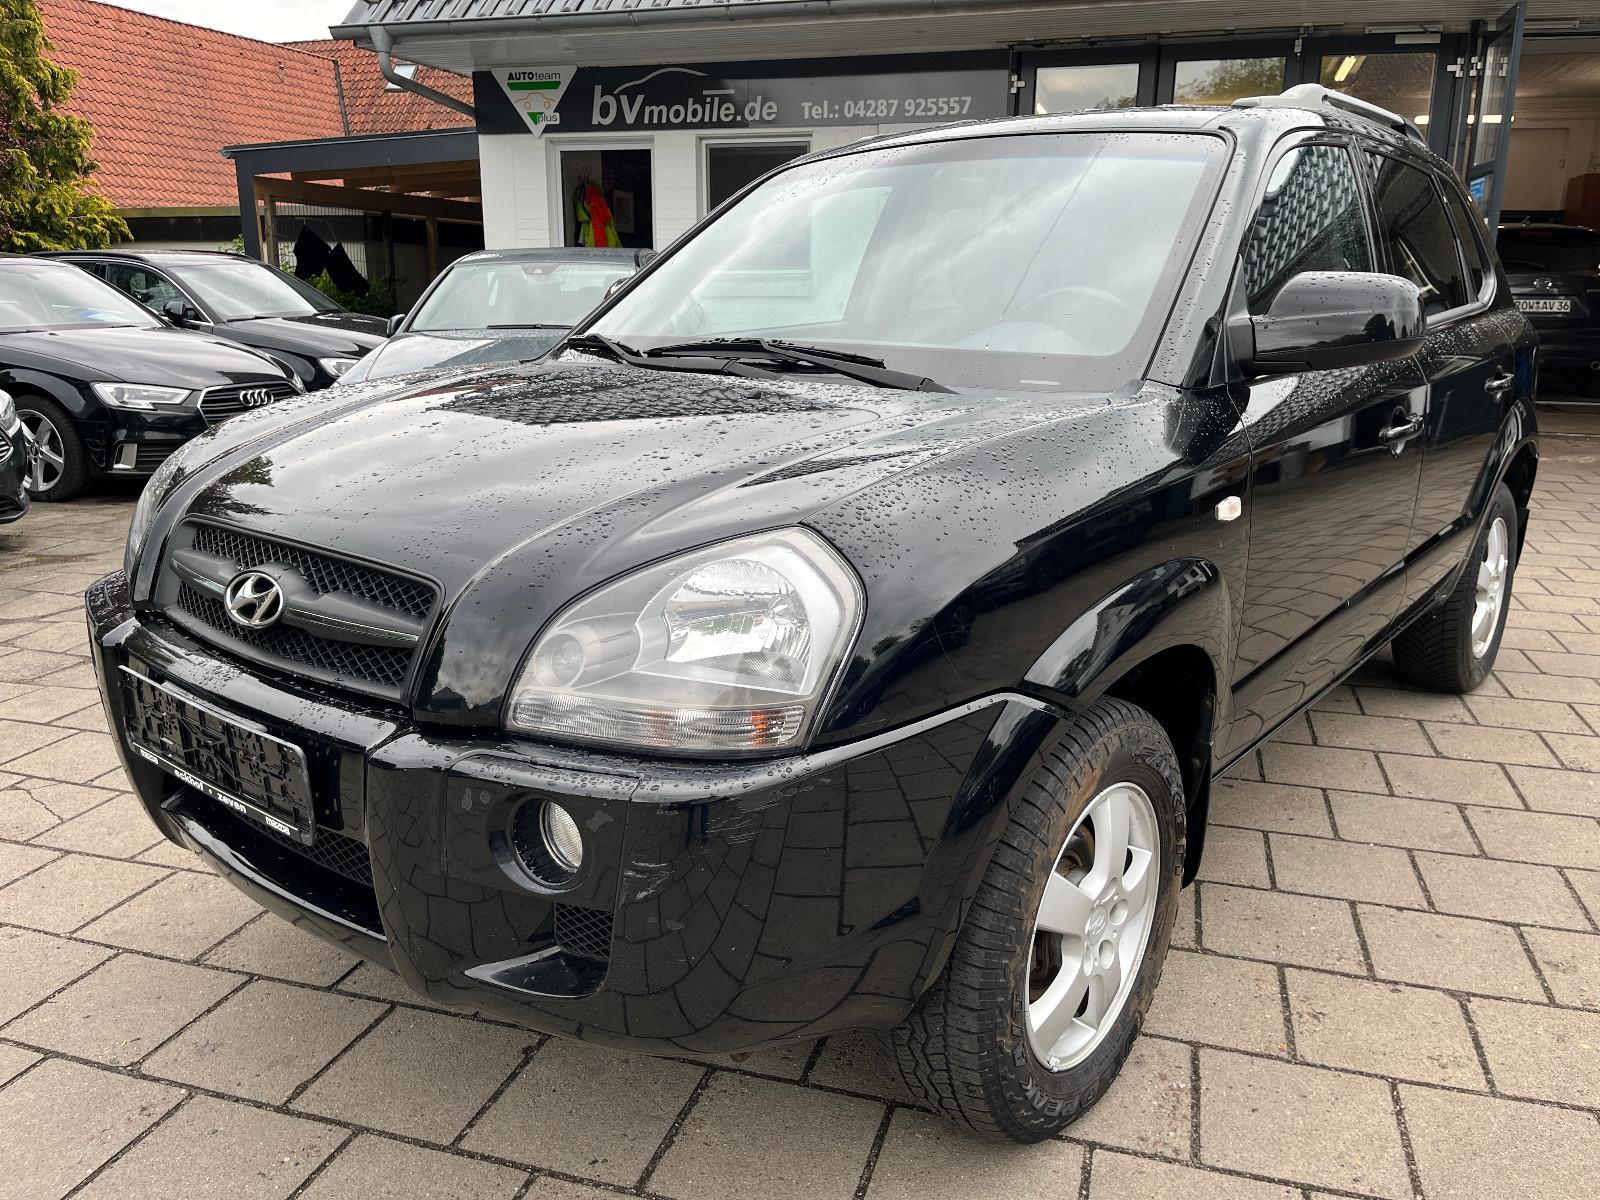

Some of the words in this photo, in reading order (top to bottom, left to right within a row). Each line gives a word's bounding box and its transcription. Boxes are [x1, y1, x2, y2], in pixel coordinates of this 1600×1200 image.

[507, 72, 561, 81] AUTOteam
[801, 101, 839, 119] Tel.:
[843, 100, 899, 118] 04287
[904, 96, 972, 116] 925557
[536, 113, 558, 124] plus
[1541, 301, 1556, 310] AV
[1556, 301, 1569, 310] 36
[217, 792, 247, 814] zeven
